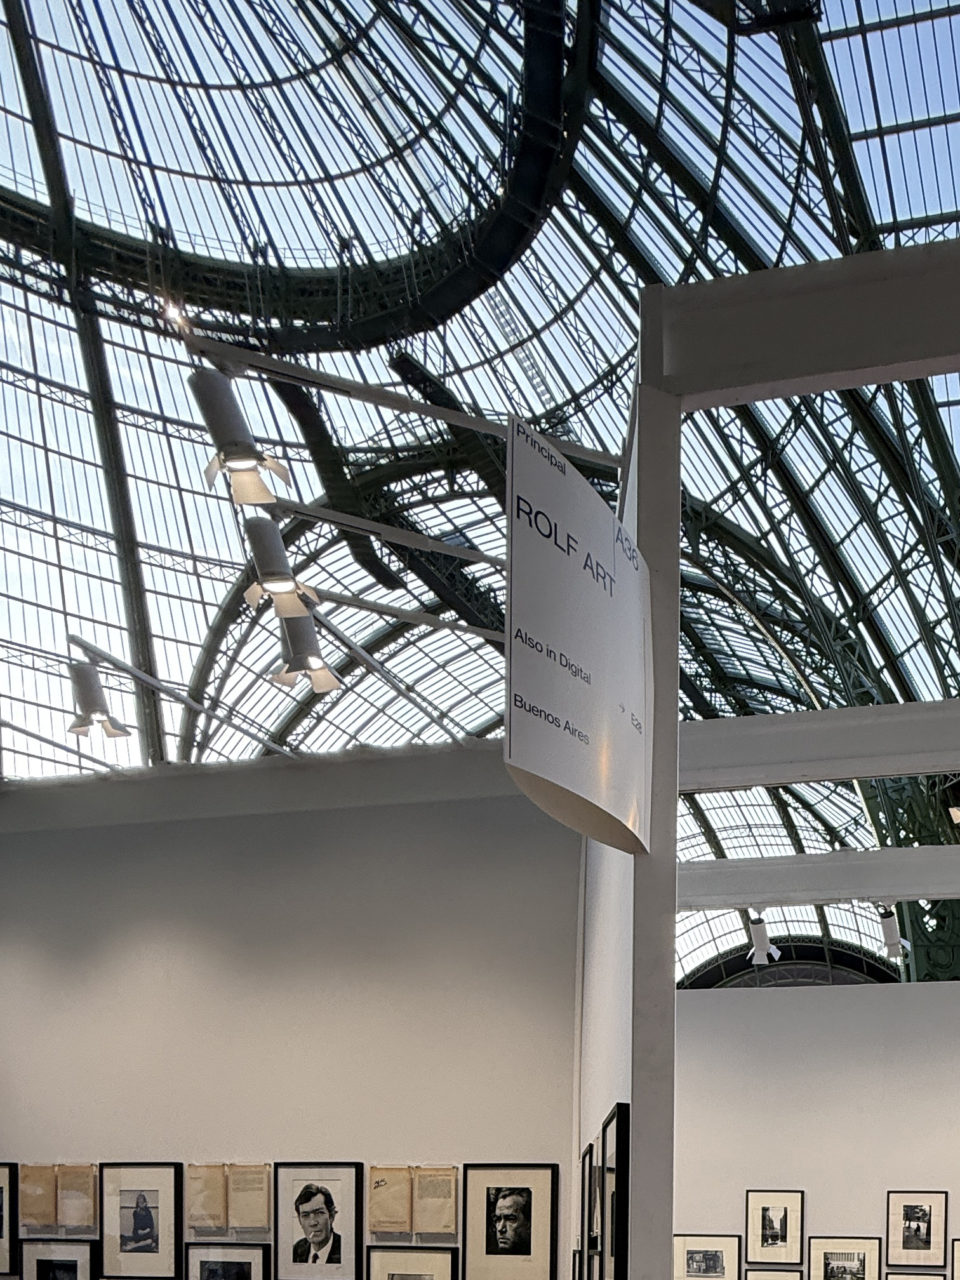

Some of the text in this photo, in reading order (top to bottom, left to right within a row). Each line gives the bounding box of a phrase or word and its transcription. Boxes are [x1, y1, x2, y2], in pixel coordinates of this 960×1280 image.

[516, 423, 566, 476] Principal
[516, 494, 616, 597] ROLF ART
[514, 628, 544, 653] Also
[546, 644, 557, 662] in
[559, 652, 592, 685] Digital
[513, 693, 590, 746] Buenos Aires
